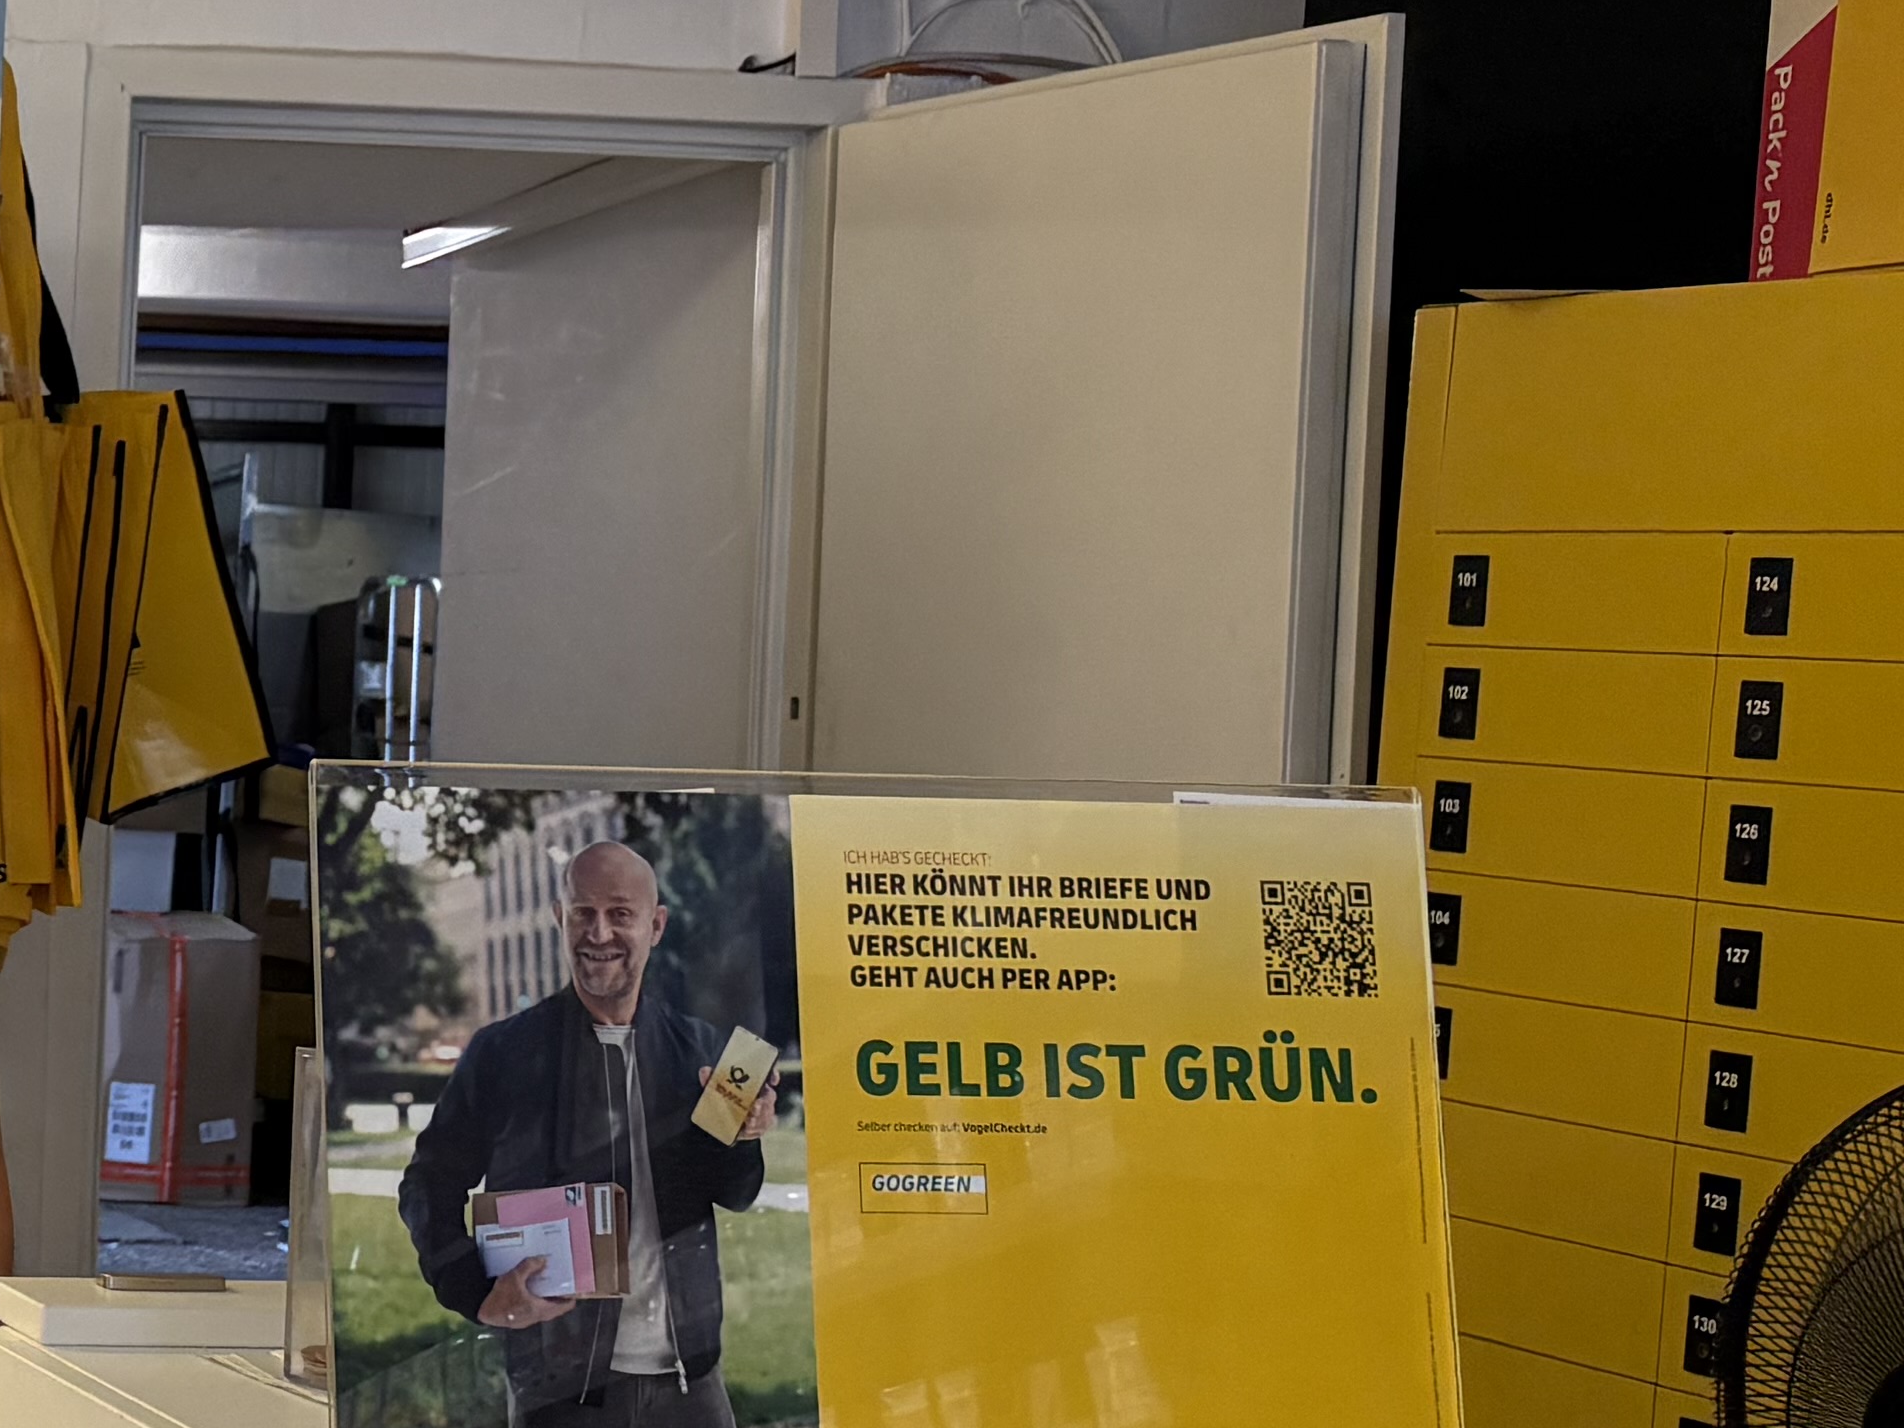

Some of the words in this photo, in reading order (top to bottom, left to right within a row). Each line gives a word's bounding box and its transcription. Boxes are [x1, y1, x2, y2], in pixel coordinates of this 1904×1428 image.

[1768, 66, 1792, 155] Pack
[1819, 192, 1834, 245] dhl.de
[1757, 199, 1782, 279] Post
[1457, 573, 1478, 588] 101
[1755, 576, 1778, 591] 124
[1745, 700, 1770, 715] 125
[1439, 798, 1460, 813] 103
[844, 850, 867, 865] ICH
[870, 851, 911, 866] HAB'S
[913, 852, 992, 867] GECHECKT:
[846, 873, 907, 895] HIER
[913, 868, 1003, 898] KÖNNT
[1009, 876, 1053, 897] IHR
[1059, 876, 1150, 900] BRIEFE
[1155, 879, 1211, 901] UND
[847, 904, 946, 927] PAKETE
[951, 906, 1198, 931] KLIMAFREUNDLICH
[848, 935, 1037, 960] VERSCHICKEN.
[1725, 948, 1750, 963] 127
[850, 966, 919, 988] GEHT
[924, 967, 995, 990] AUCH
[1001, 968, 1051, 990] PER
[1057, 969, 1117, 991] APP:
[856, 1040, 1025, 1097] GELB
[1043, 1042, 1146, 1099] IST
[1163, 1030, 1378, 1104] GRÜN.
[1715, 1072, 1738, 1088] 128
[872, 1175, 971, 1194] GOGREEN
